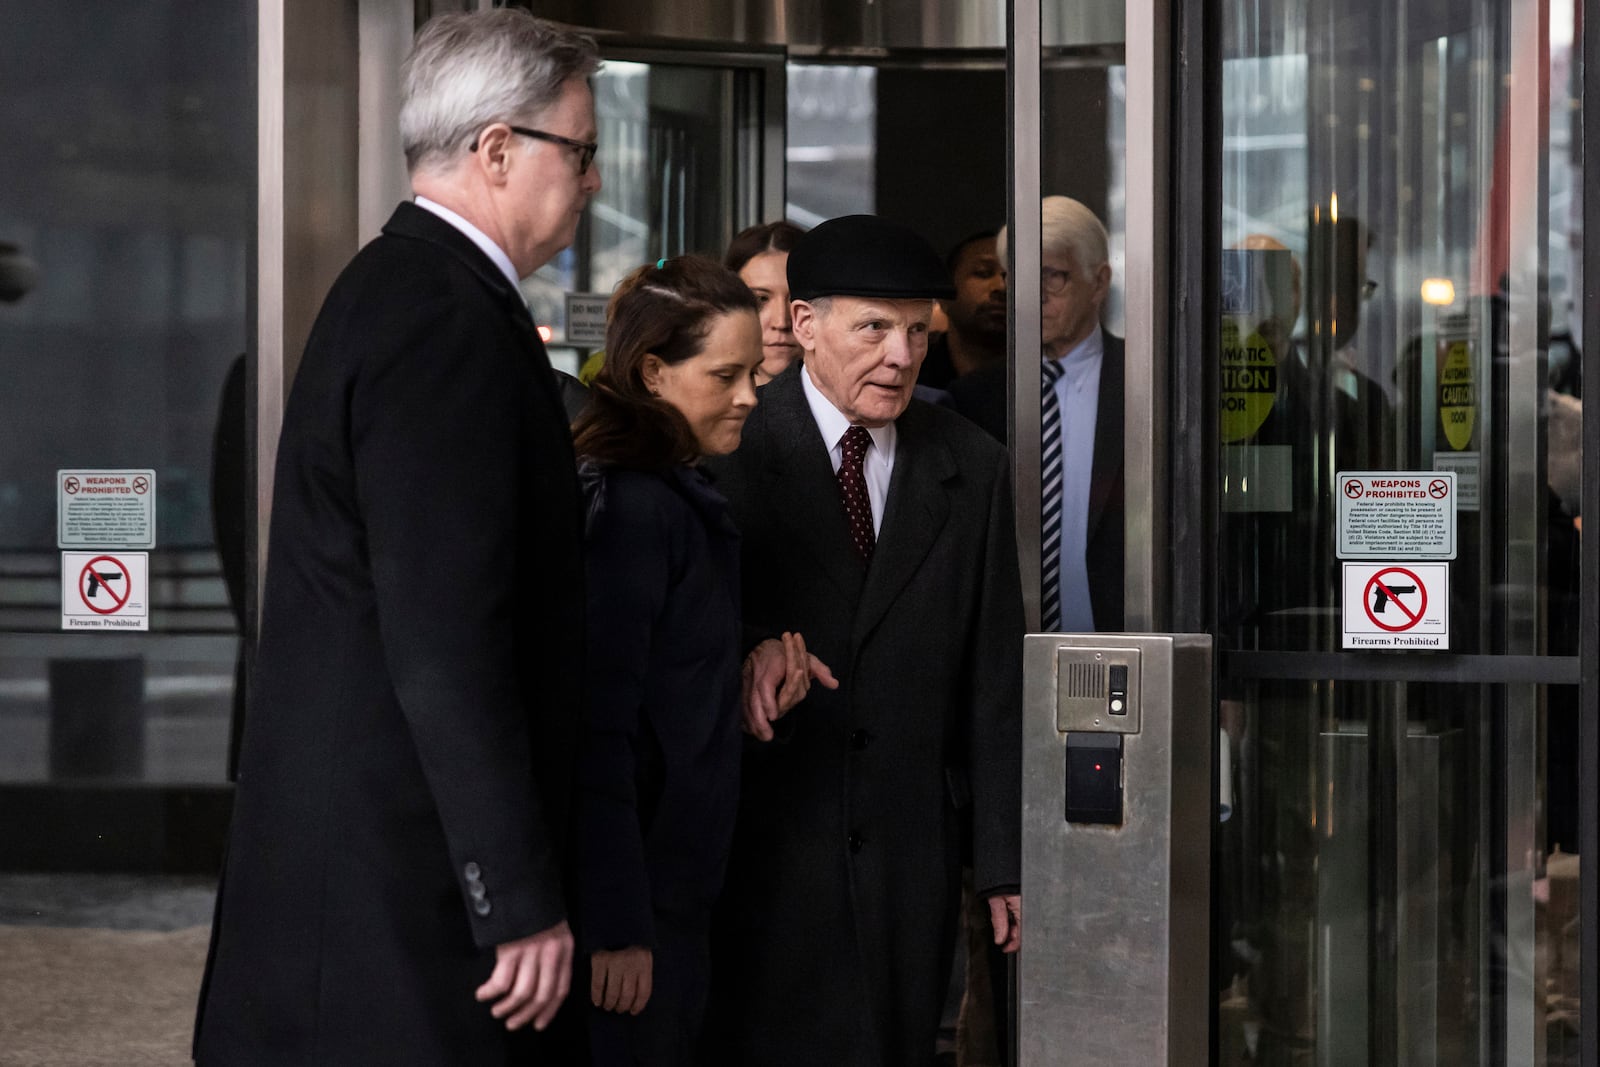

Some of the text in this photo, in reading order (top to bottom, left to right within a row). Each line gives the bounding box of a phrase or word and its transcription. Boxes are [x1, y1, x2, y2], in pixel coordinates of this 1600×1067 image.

[1443, 386, 1474, 404] CAUTION
[1371, 480, 1421, 488] WEAPONS
[103, 619, 141, 627] Prohibited
[1352, 637, 1439, 646] Firearms Prohibited
